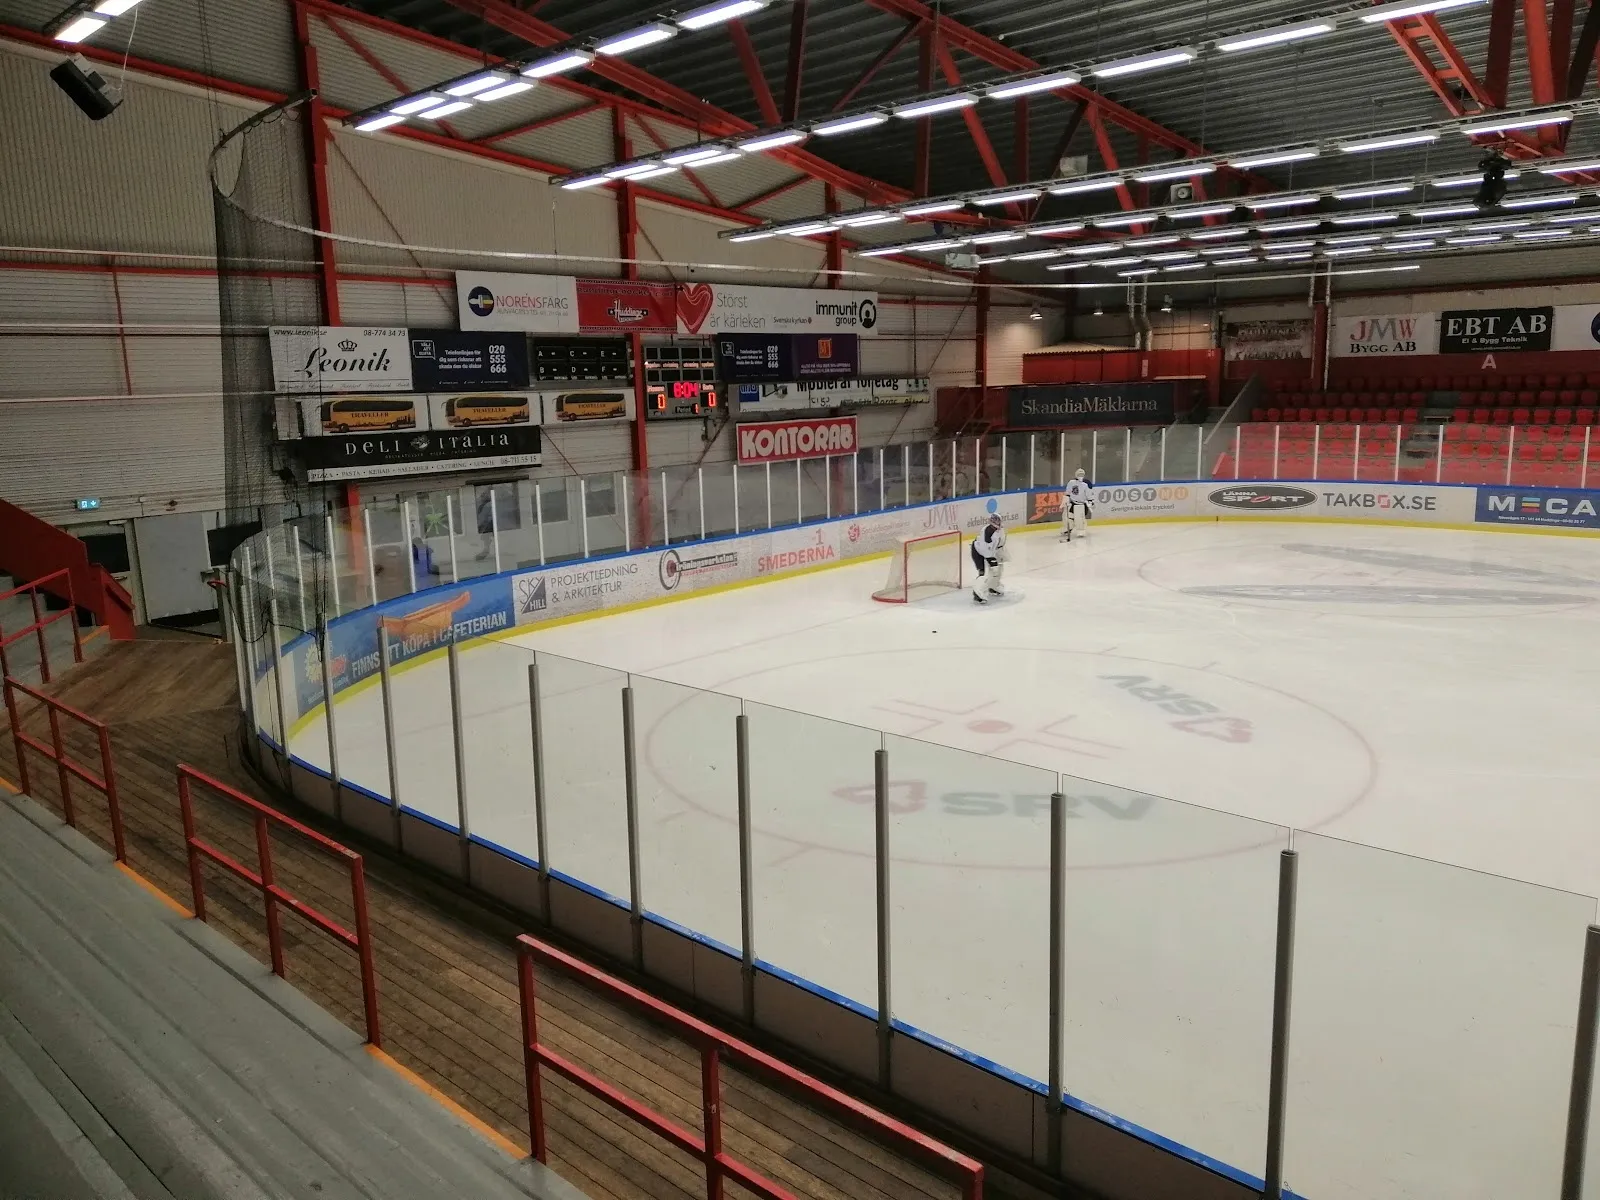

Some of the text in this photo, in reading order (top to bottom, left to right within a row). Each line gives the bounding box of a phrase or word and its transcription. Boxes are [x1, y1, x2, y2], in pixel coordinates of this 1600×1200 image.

[716, 292, 748, 308] Störst
[815, 300, 857, 316] immunit
[709, 313, 766, 328] är kärleken
[835, 316, 857, 326] group
[1446, 314, 1547, 336] EBT AB
[1350, 317, 1417, 341] JMW
[488, 344, 505, 354] 020
[766, 345, 779, 353] 020
[1350, 341, 1417, 353] BYGG AB
[1479, 337, 1499, 345] Bygg
[294, 347, 390, 378] Leonik
[489, 354, 506, 364] 555
[767, 353, 779, 361] 555
[1481, 354, 1496, 369] A
[490, 364, 507, 374] 666
[657, 393, 666, 409] 0
[708, 391, 717, 407] 0
[1021, 395, 1157, 416] SkandiaMäklarna
[741, 423, 854, 459] KONTORAB
[1222, 495, 1305, 503] SPORT
[1323, 492, 1437, 511] TAKBOX.SE
[1488, 495, 1597, 516] MECA
[758, 545, 835, 573] SMEDERNA
[550, 563, 638, 588] PROJEKTLEDNING
[551, 581, 622, 603] & ARKITEKTUR
[529, 598, 546, 611] HILL
[352, 651, 381, 678] FINNS
[402, 631, 430, 657] KÖPA
[440, 611, 507, 642] CAFETERIAN
[941, 790, 1157, 821] SRV
